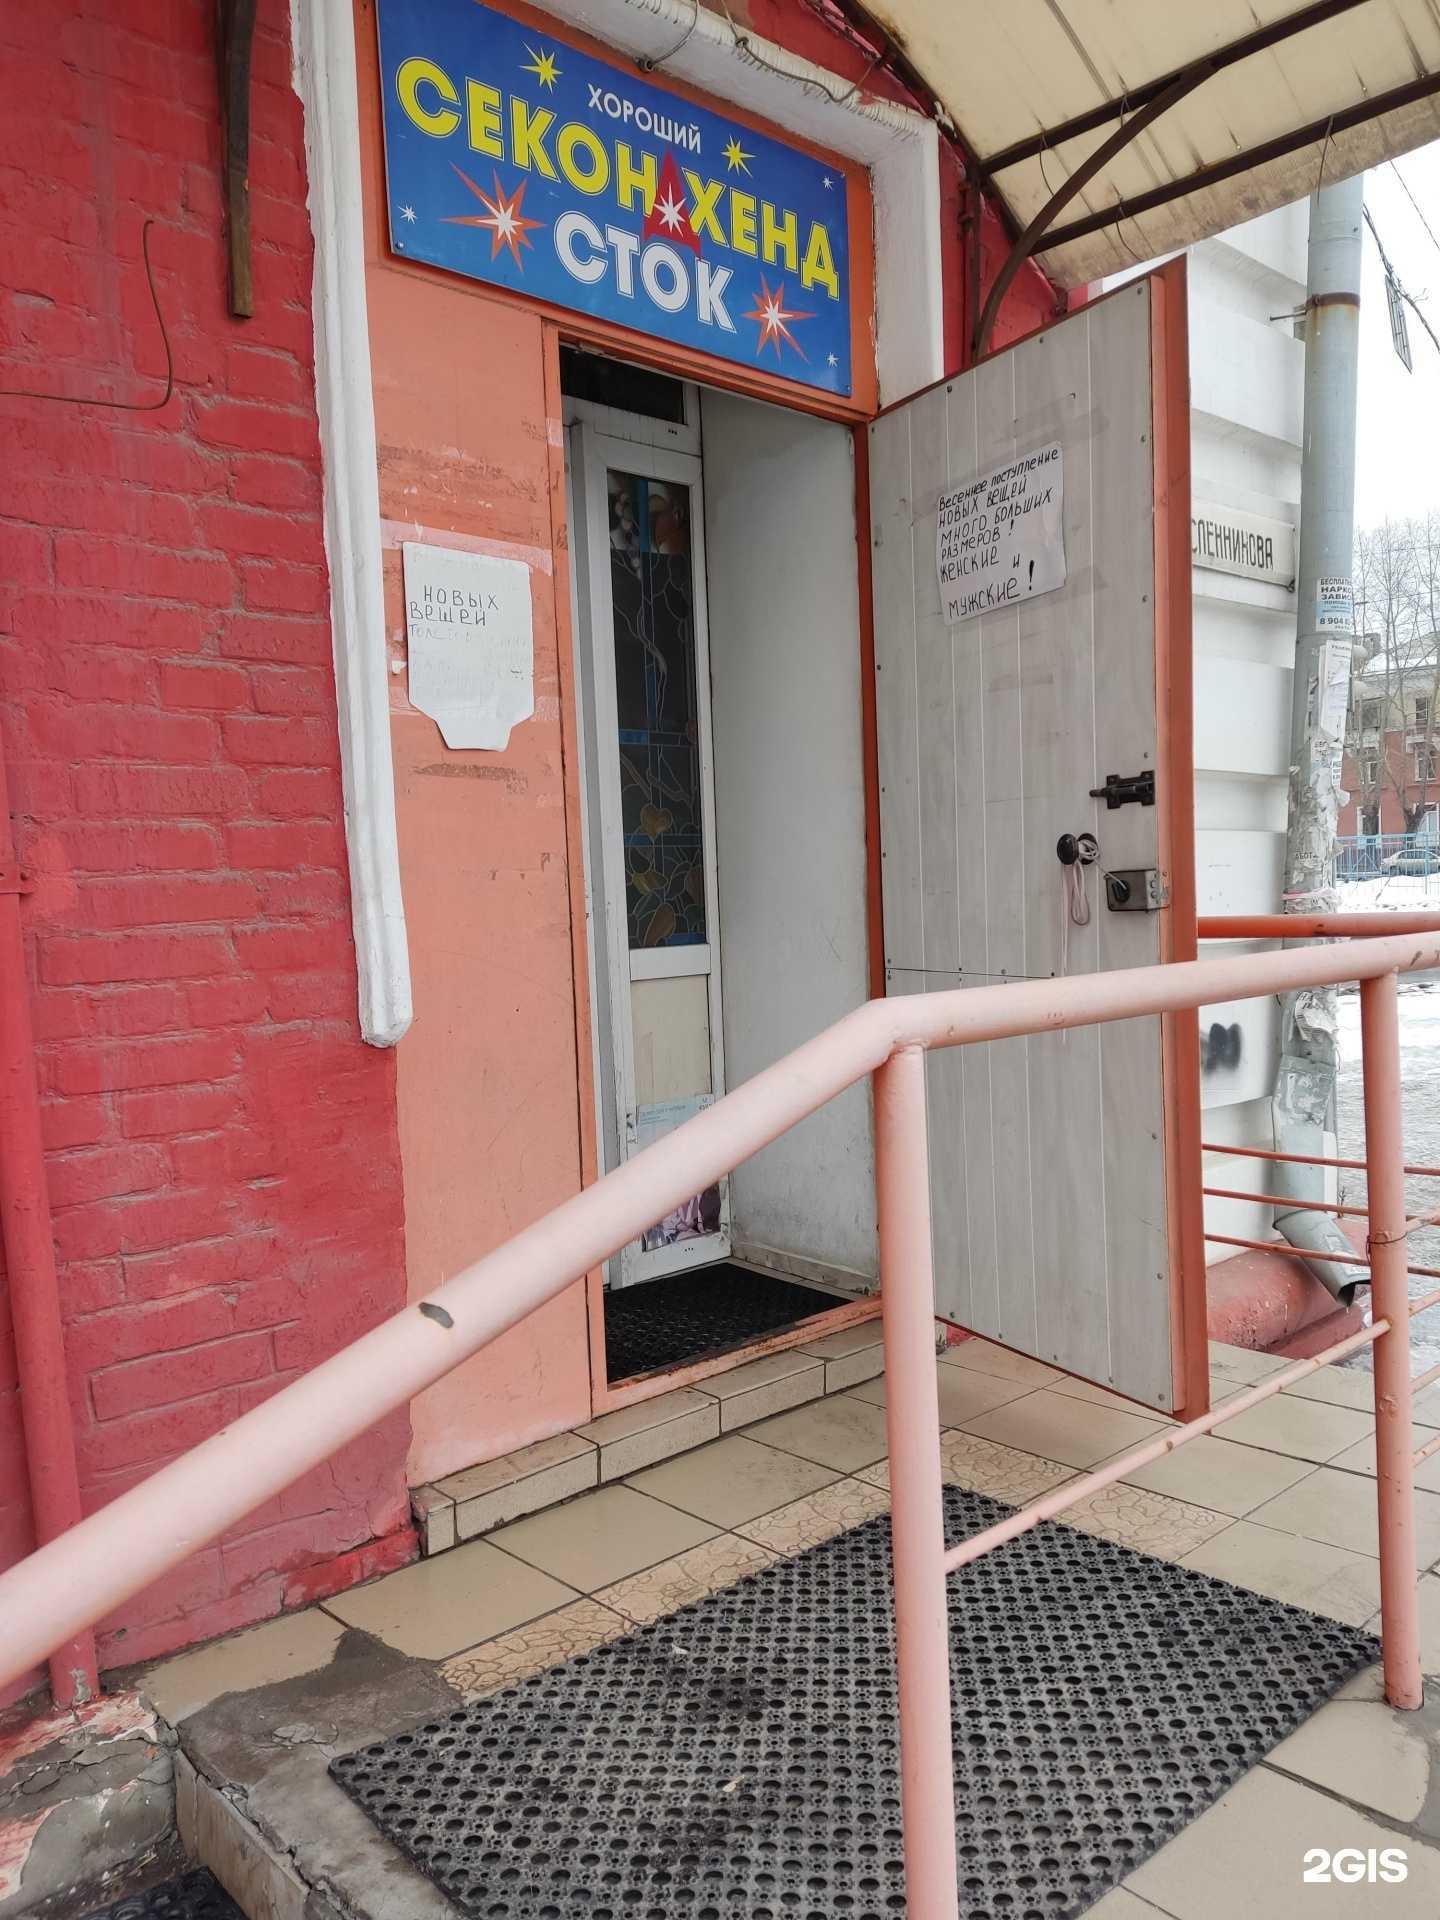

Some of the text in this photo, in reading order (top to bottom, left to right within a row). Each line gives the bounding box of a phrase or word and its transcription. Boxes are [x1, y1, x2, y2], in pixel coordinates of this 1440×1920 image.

[588, 84, 701, 154] ХОРОШИЙ
[554, 210, 736, 334] СТОК
[941, 487, 1053, 547] МНОГО БОЛЬШИХ
[424, 584, 499, 610] НОВЫХ
